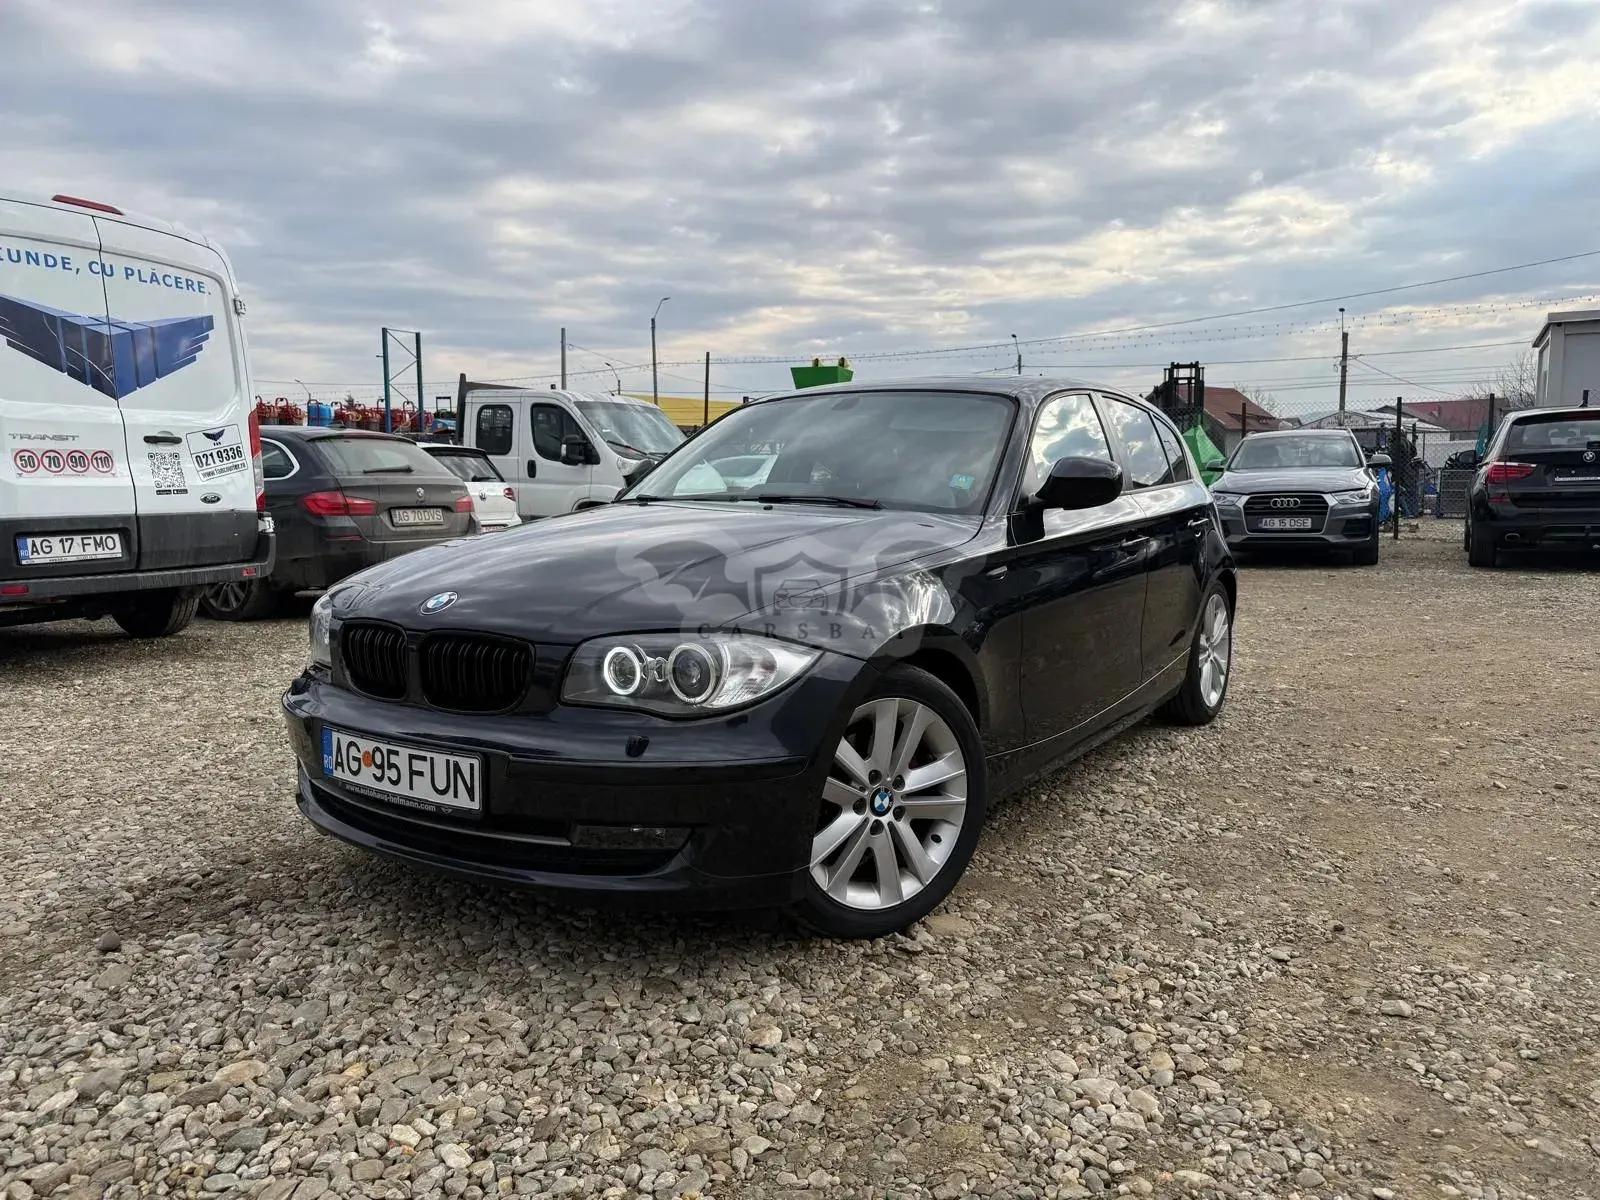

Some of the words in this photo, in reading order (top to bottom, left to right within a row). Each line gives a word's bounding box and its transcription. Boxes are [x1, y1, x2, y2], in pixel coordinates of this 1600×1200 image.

[88, 261, 114, 277] CU
[124, 267, 212, 295] PLĂCERE.
[8, 432, 79, 441] TRANSIT
[19, 455, 36, 469] 50
[45, 455, 61, 469] 70
[69, 455, 87, 469] 90
[94, 455, 111, 470] 110
[397, 510, 410, 522] AG
[1263, 518, 1275, 527] AG
[1279, 518, 1287, 527] 15
[1289, 518, 1310, 527] DSE
[20, 549, 29, 557] RO
[31, 539, 53, 556] AG
[59, 537, 75, 554] 17
[81, 535, 117, 553] FMO
[323, 754, 333, 770] RO
[334, 737, 362, 777] AG
[371, 746, 401, 787] 95
[408, 753, 475, 803] FUN
